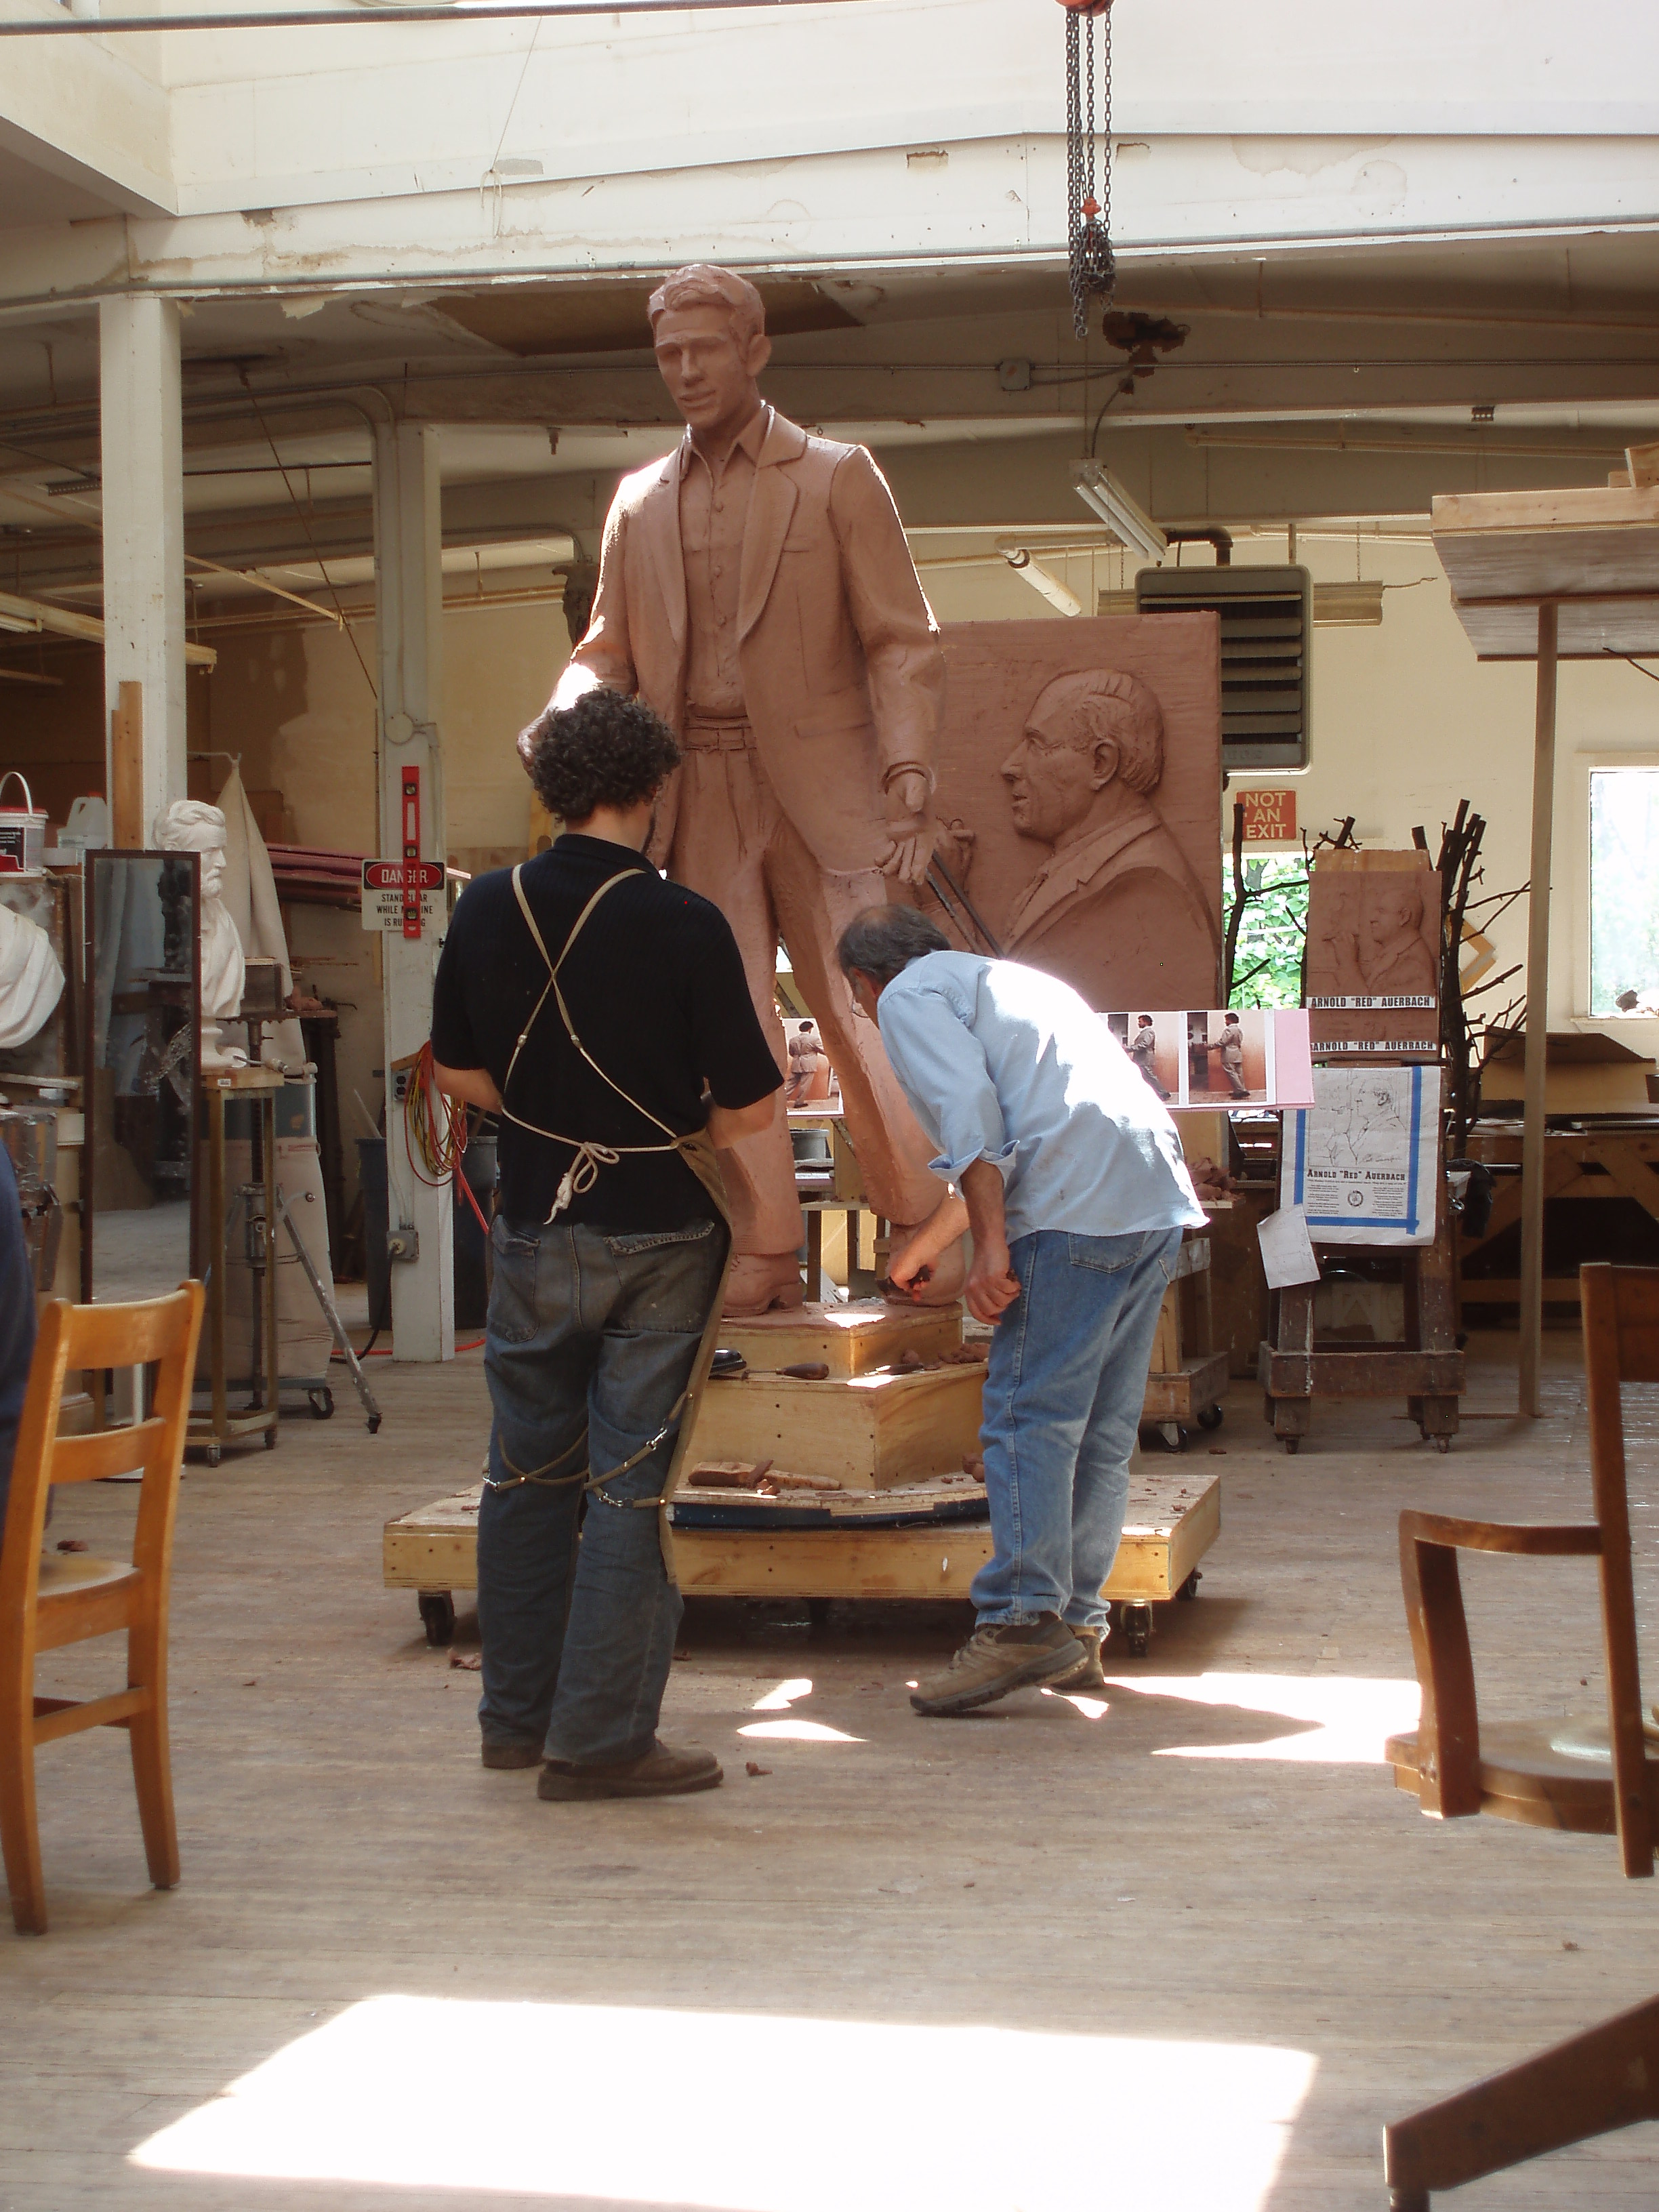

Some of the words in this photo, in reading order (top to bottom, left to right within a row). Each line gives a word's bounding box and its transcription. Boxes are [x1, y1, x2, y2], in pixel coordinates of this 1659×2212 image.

[1246, 792, 1286, 807] NOT
[1253, 808, 1280, 823] AN
[1246, 823, 1286, 838] EXIT
[382, 894, 404, 903] STAND
[377, 905, 398, 914] WHILE
[384, 918, 391, 926] IS
[1311, 997, 1346, 1008] ARNOLD
[1351, 997, 1376, 1007] "RED"
[1381, 996, 1430, 1007] AUERBACH
[1313, 1042, 1348, 1051] ARNOLD
[1353, 1042, 1379, 1050] "RED"
[1385, 1041, 1433, 1050] AUERBACH
